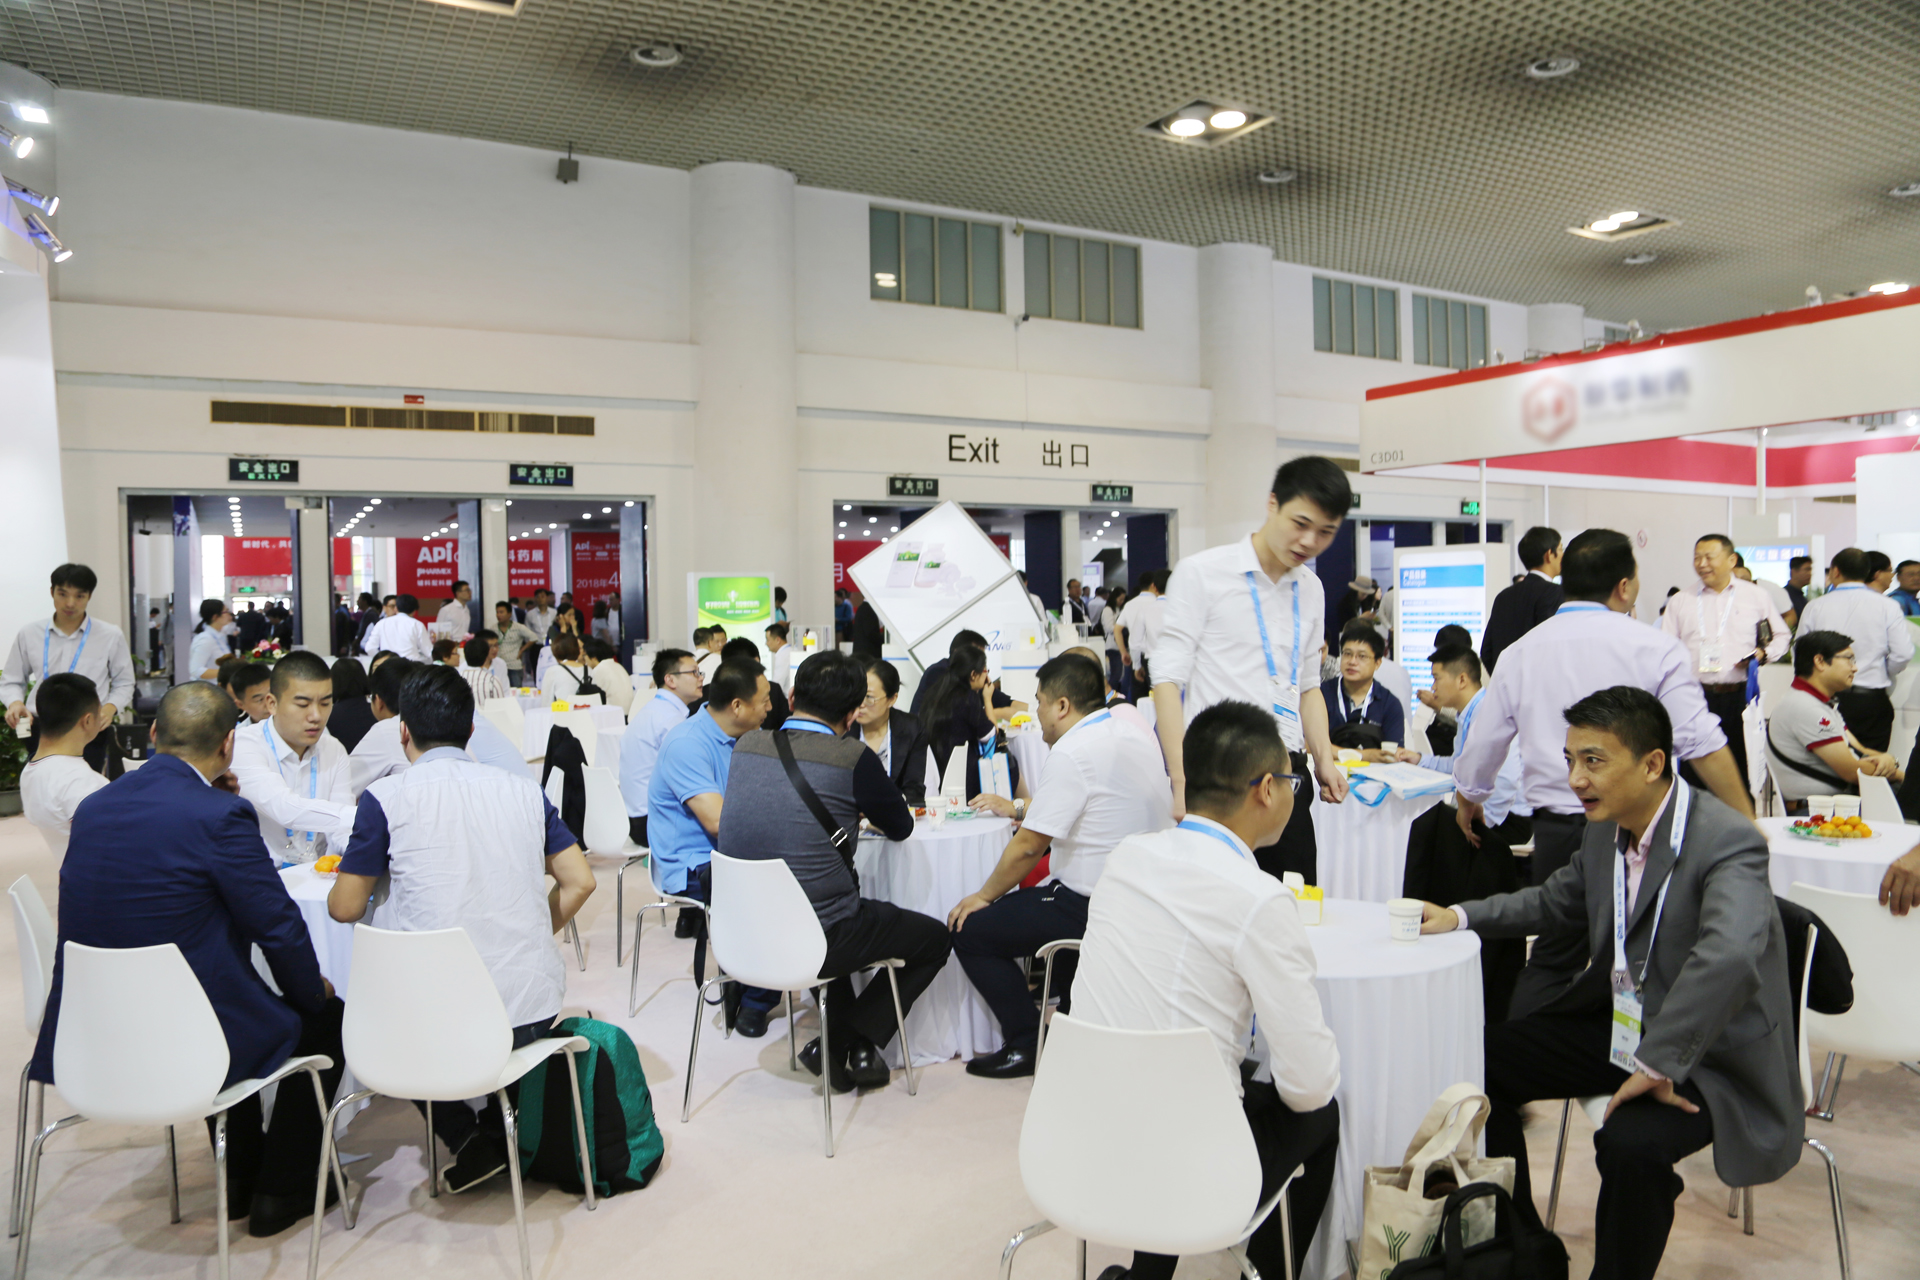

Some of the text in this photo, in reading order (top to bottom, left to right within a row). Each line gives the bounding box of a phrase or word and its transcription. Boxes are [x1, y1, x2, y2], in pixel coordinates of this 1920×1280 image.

[948, 433, 999, 463] Exit
[1042, 440, 1089, 468] 出口
[1370, 449, 1404, 464] C3D01
[238, 461, 290, 474] 安全出口
[517, 467, 566, 478] 安全出口
[247, 472, 281, 480] EXIT
